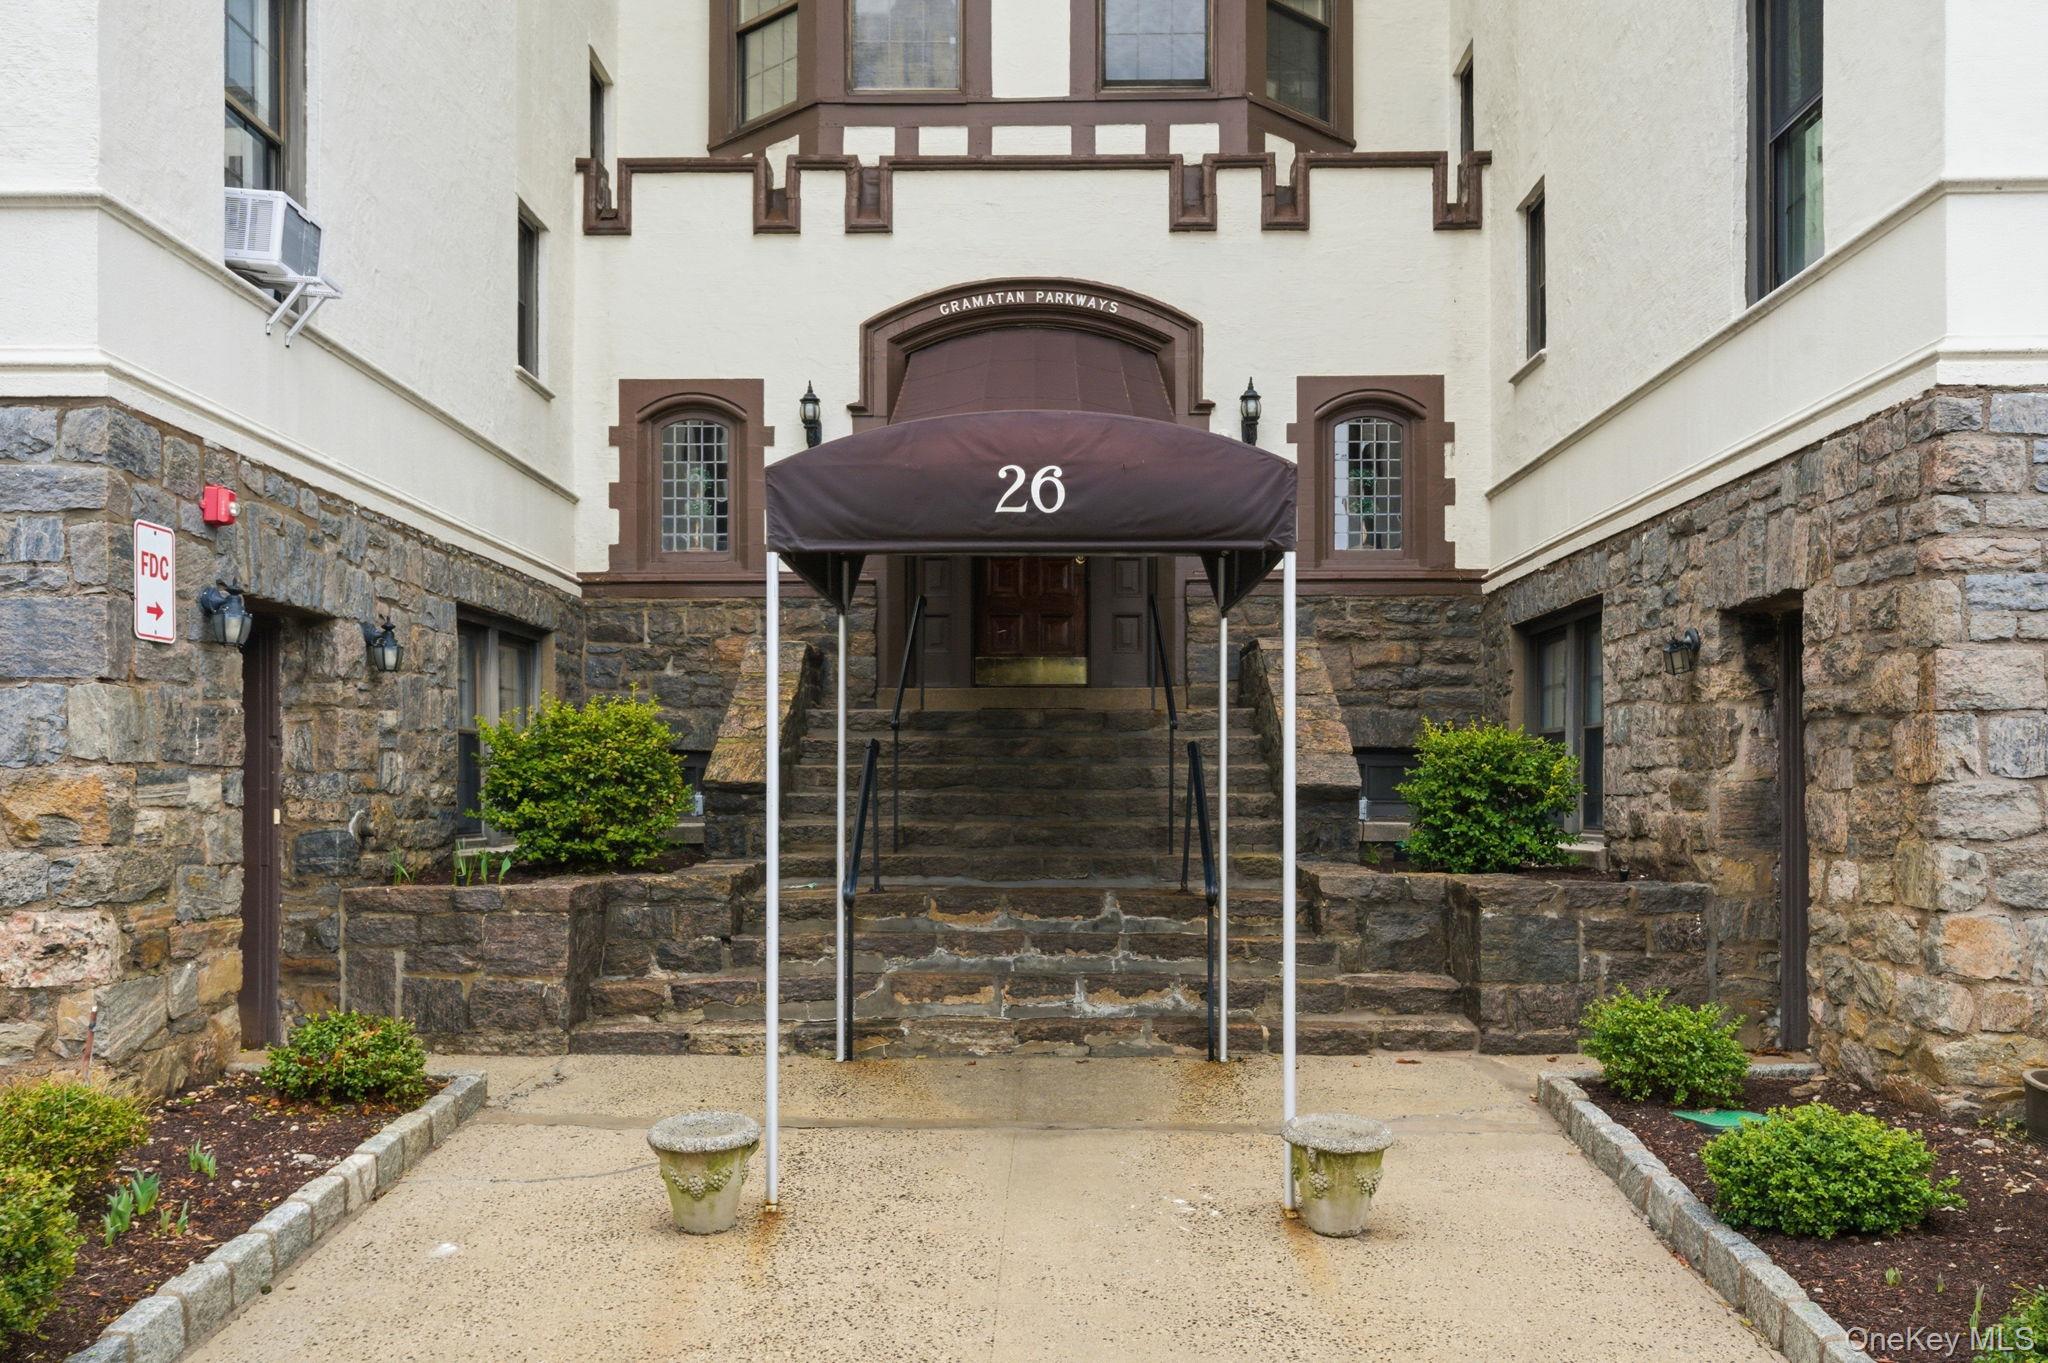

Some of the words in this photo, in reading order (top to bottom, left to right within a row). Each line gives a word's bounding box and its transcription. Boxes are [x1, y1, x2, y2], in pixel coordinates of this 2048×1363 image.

[939, 291, 1025, 315] GRAMATAN
[1036, 291, 1119, 313] PARKWAYS
[995, 464, 1066, 513] 26
[141, 550, 169, 581] FDC
